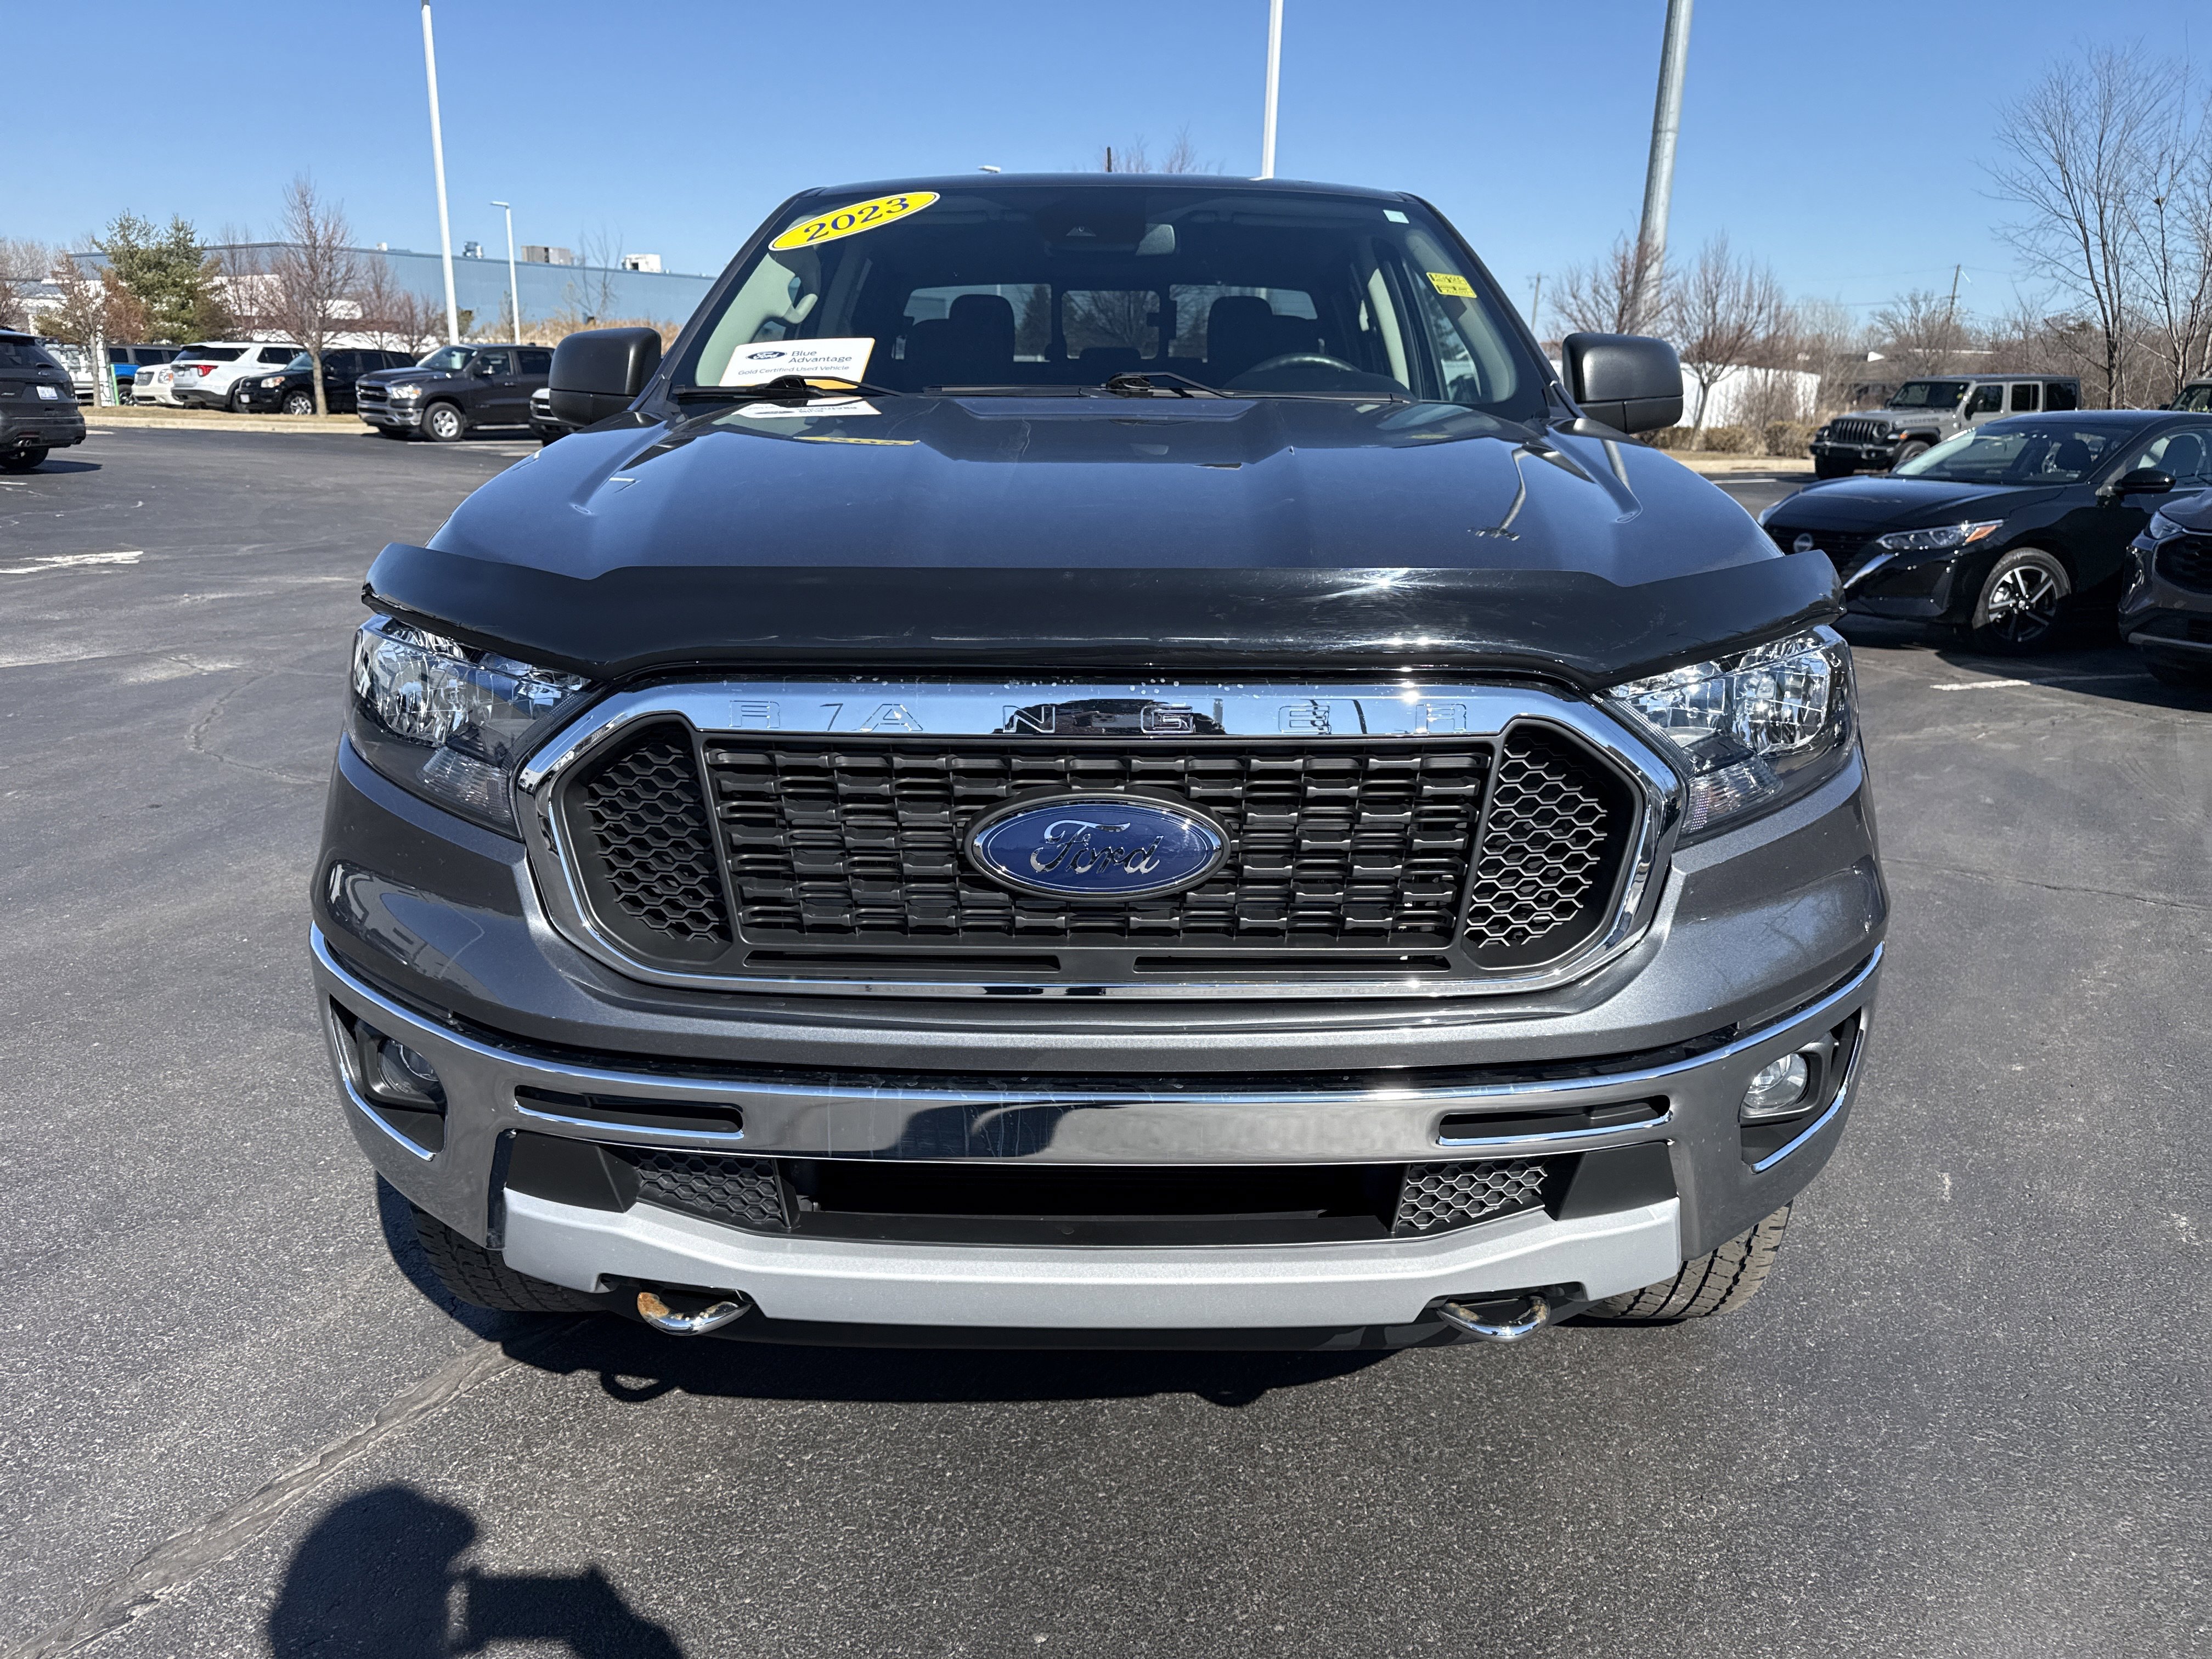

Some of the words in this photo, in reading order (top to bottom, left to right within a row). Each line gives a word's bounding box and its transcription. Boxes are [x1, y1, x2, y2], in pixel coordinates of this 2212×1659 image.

[804, 198, 909, 242] 2023
[752, 351, 781, 360] Ford
[729, 700, 1467, 735] RANGER
[1030, 820, 1164, 874] Ford
